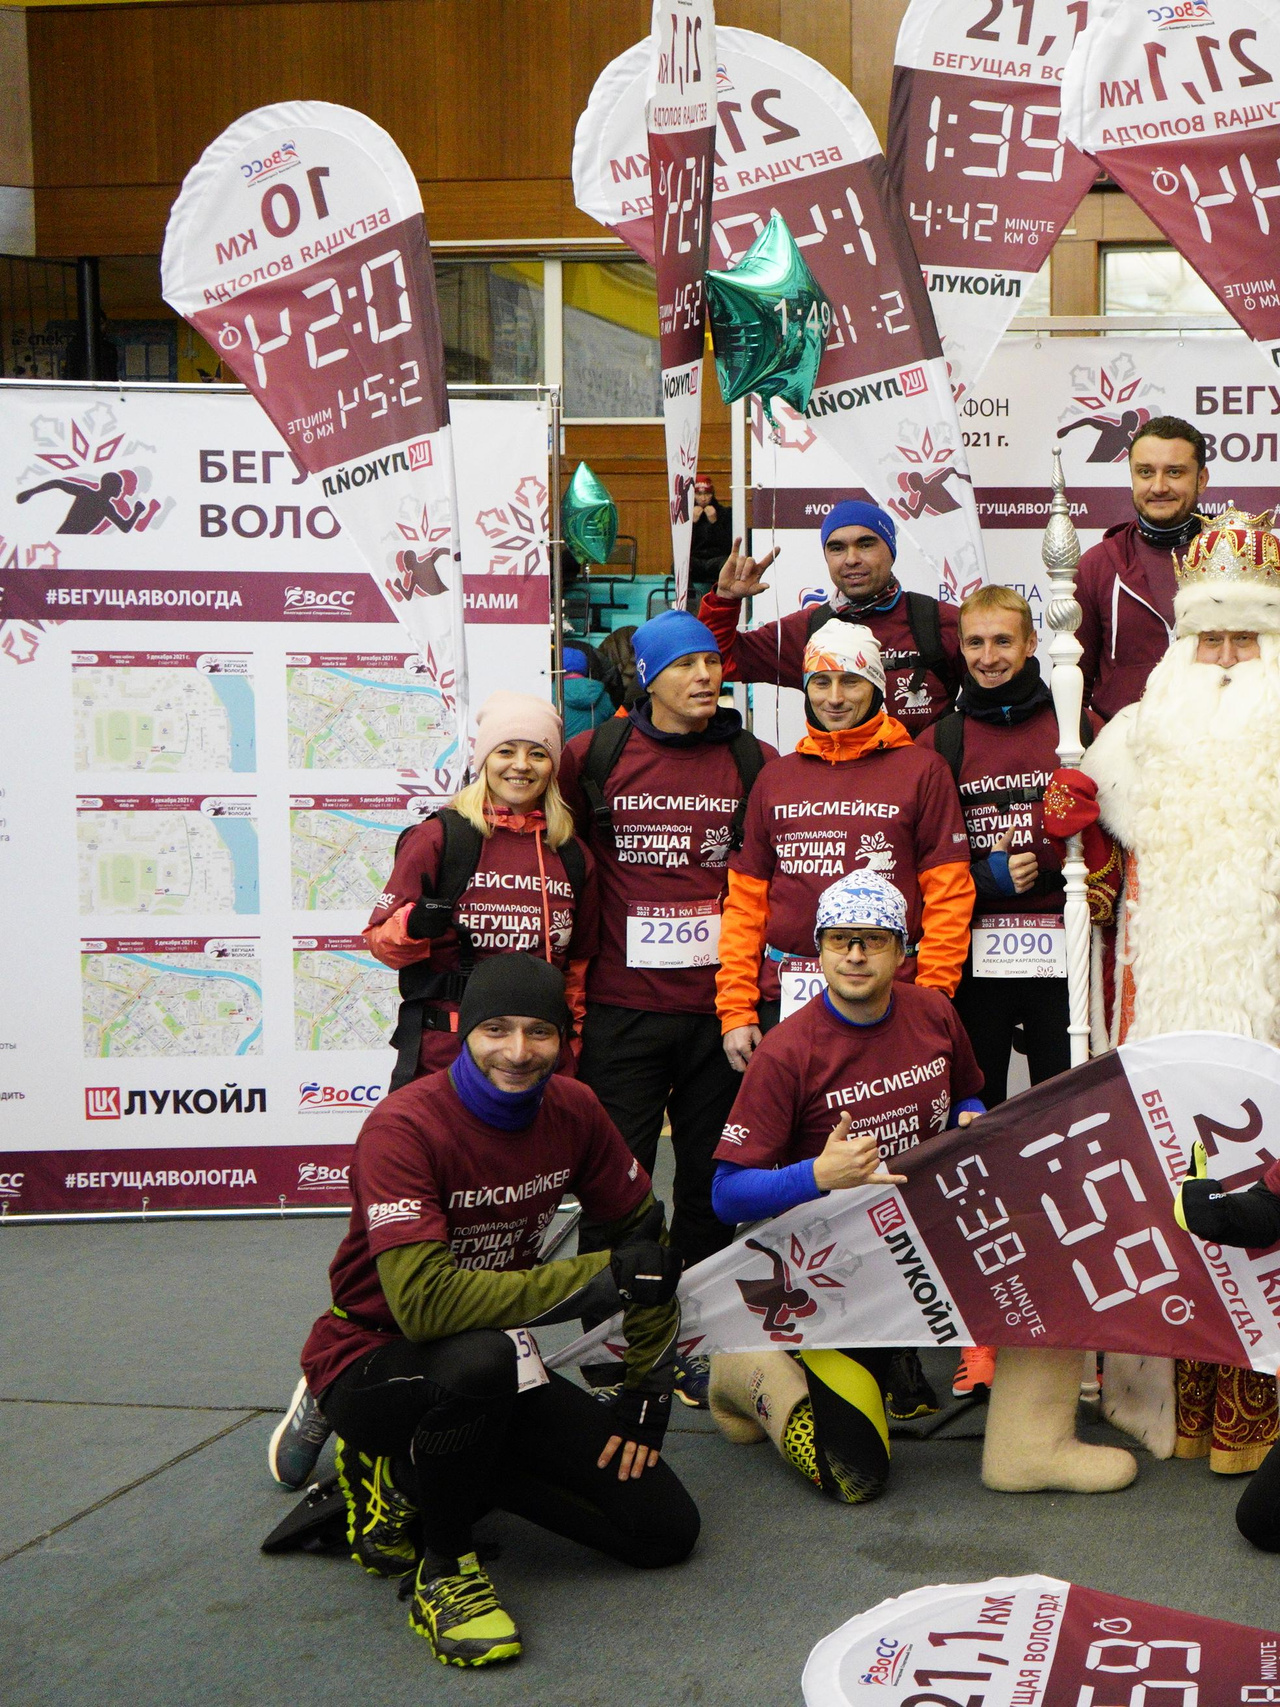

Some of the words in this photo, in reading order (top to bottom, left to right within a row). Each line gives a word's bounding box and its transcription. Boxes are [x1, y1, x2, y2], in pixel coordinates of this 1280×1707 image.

[933, 52, 1032, 79] БЕГУЩАЯ
[909, 200, 997, 242] 4:42
[1004, 218, 1055, 233] MINUTE
[929, 273, 1021, 298] ЛУКОЙЛ
[200, 449, 306, 485] БЕГУ
[200, 504, 342, 540] ВОЛО
[46, 587, 243, 609] #БЕГУЩАЯВОЛОГДА
[463, 593, 518, 609] НАМИ
[960, 770, 1054, 796] ПЕЙСМЕЙК
[613, 793, 739, 812] ПЕЙСМЕЙКЕР
[774, 800, 900, 820] ПЕЙСМЕЙКЕР
[971, 803, 1032, 816] ПОЛУМАФОН
[623, 825, 692, 833] ПОЛУМАРАФОН
[967, 813, 1032, 833] БЕГУЩАЯ
[615, 835, 690, 851] БЕГУЩАЯ
[785, 831, 847, 841] ПОЛУМАРАФОН
[970, 830, 1033, 849] ВОЛОДА
[618, 850, 689, 868] ВОЛОГДА
[777, 842, 846, 858] БЕГУЩАЯ
[781, 859, 844, 876] ВОЛОГДА
[470, 903, 541, 914] ПОЛУМАРАФОН
[652, 907, 675, 917] 21,1
[459, 913, 541, 932] БЕГУЩАЯ
[641, 920, 709, 944] 2266
[998, 918, 1020, 928] 21,1
[470, 933, 539, 950] ОЛОГДА
[986, 933, 1053, 956] 2090
[793, 978, 823, 1000] 20
[826, 1056, 946, 1109] ПЕЙСМЕЙКЕР
[124, 1083, 267, 1115] ЛУКОЙЛ
[851, 1103, 918, 1129] ОЛУМАРАФОН
[65, 1169, 258, 1190] #БЕГУЩАЯВОЛОГДА
[449, 1168, 570, 1209] ПЕЙСМЕЙКЕР
[936, 1154, 1026, 1276] 5:38
[1019, 1112, 1180, 1312] 1:59
[1141, 1090, 1188, 1186] БЕГУЩ
[1200, 1238, 1264, 1347] ОЛОГДА
[453, 1217, 528, 1236] ПОЛУМАРАФОН
[451, 1229, 524, 1254] ЕГУЩАЯ
[884, 1232, 958, 1345] ЛУКОЙЛ
[1007, 1275, 1046, 1338] MINUTE
[1023, 1593, 1063, 1662] ВОЛОГДА
[1261, 1640, 1277, 1680] MINUTE
